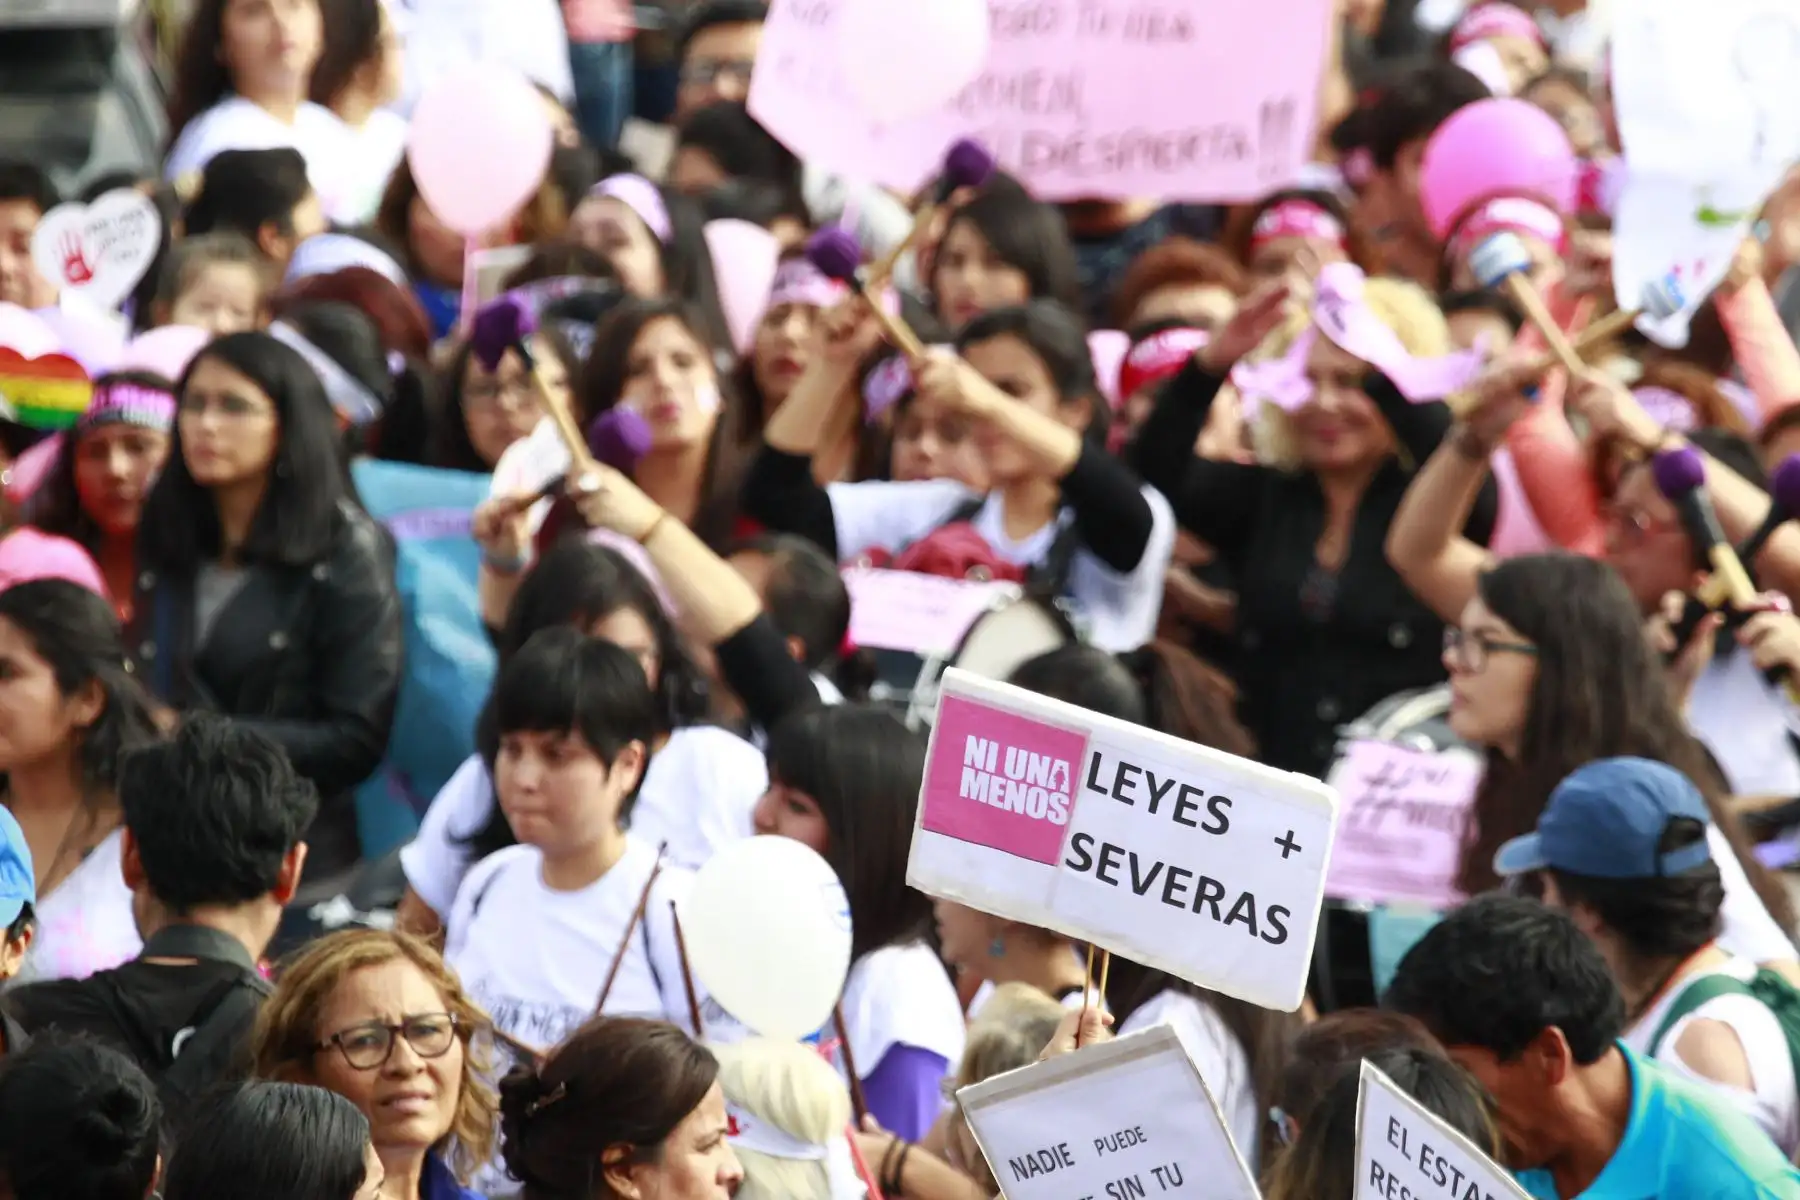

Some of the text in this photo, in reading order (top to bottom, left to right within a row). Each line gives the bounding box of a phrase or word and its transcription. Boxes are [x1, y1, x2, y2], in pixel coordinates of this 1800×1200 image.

[964, 734, 1071, 794] NI UNA
[1086, 751, 1233, 835] LEYES
[959, 766, 1070, 826] MENOS
[1065, 832, 1291, 945] SEVERAS
[1008, 1126, 1148, 1182] NADIE PUEDE
[1105, 1162, 1184, 1200] SIN TU
[1369, 1159, 1421, 1200] RES
[1386, 1115, 1496, 1200] EL ESTA
